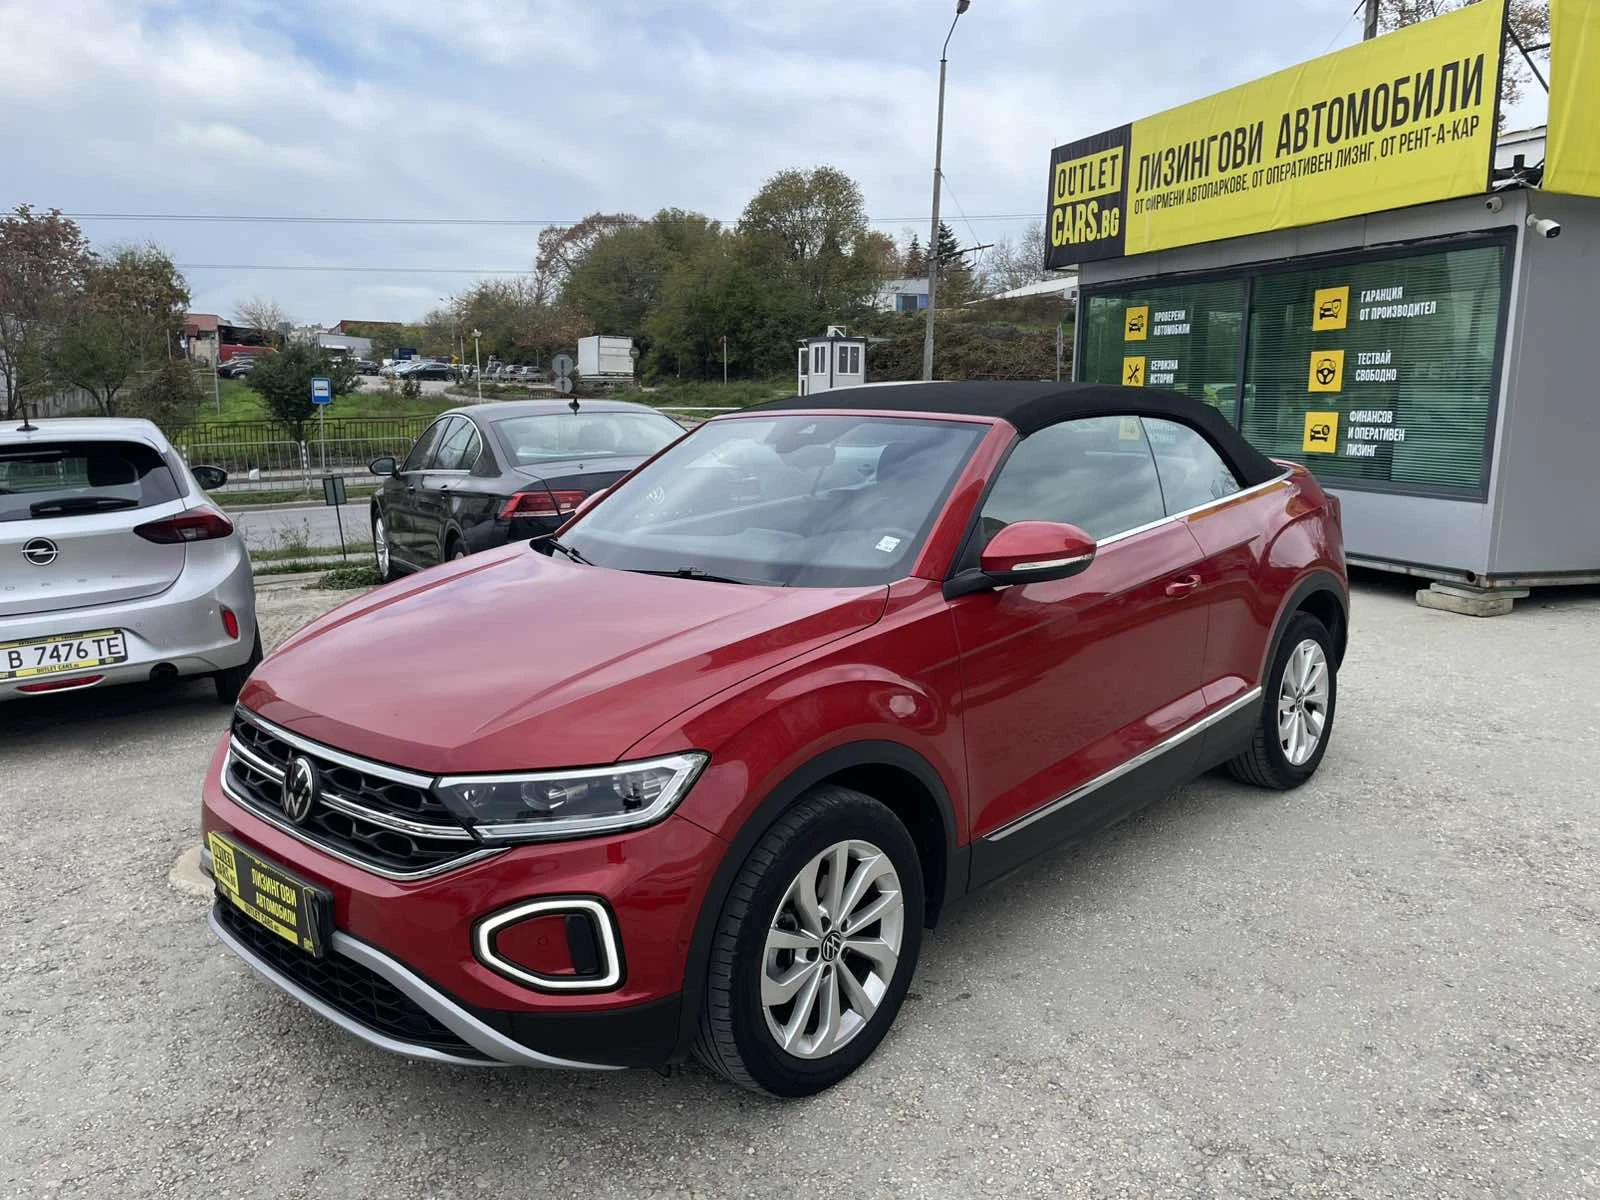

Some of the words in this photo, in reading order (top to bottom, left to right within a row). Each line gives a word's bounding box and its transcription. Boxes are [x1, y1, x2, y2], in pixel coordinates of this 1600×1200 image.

[1136, 121, 1264, 193] ЛИЗИНГОВИ
[1276, 54, 1485, 158] АВТОМОБИЛИ
[1057, 154, 1119, 198] OUTLET
[1134, 199, 1145, 215] ОТ
[1146, 190, 1185, 211] ФИРМЕНИ
[1186, 174, 1249, 203] АВТОПАРКОВЕ,
[1252, 169, 1264, 188] ОТ
[1266, 156, 1332, 185] ОПЕРАТИВЕН
[1381, 135, 1397, 157] ОТ
[1399, 115, 1480, 154] РЕНТ-А-КАР
[1052, 201, 1119, 247] CARS.BG
[1361, 287, 1403, 302] ГАРАНЦИЯ
[1360, 308, 1370, 320] ОТ
[1371, 301, 1436, 319] ПРОИЗВОДИТЕЛ
[1358, 350, 1391, 364] ТЕСТВАЙ
[1356, 369, 1397, 382] СВОБОДНО
[1349, 411, 1393, 423] ФИНАНСОВ
[1347, 427, 1354, 439] И
[1355, 427, 1405, 441] ОПЕРАТИВЕН
[1346, 444, 1378, 457] ЛИЗИНГ
[8, 650, 23, 669] B
[34, 641, 88, 666] 7476
[92, 637, 122, 657] TE
[252, 868, 297, 907] ЛИЗИНГОВИ
[256, 891, 297, 927] АВТОМОБИЛИ
